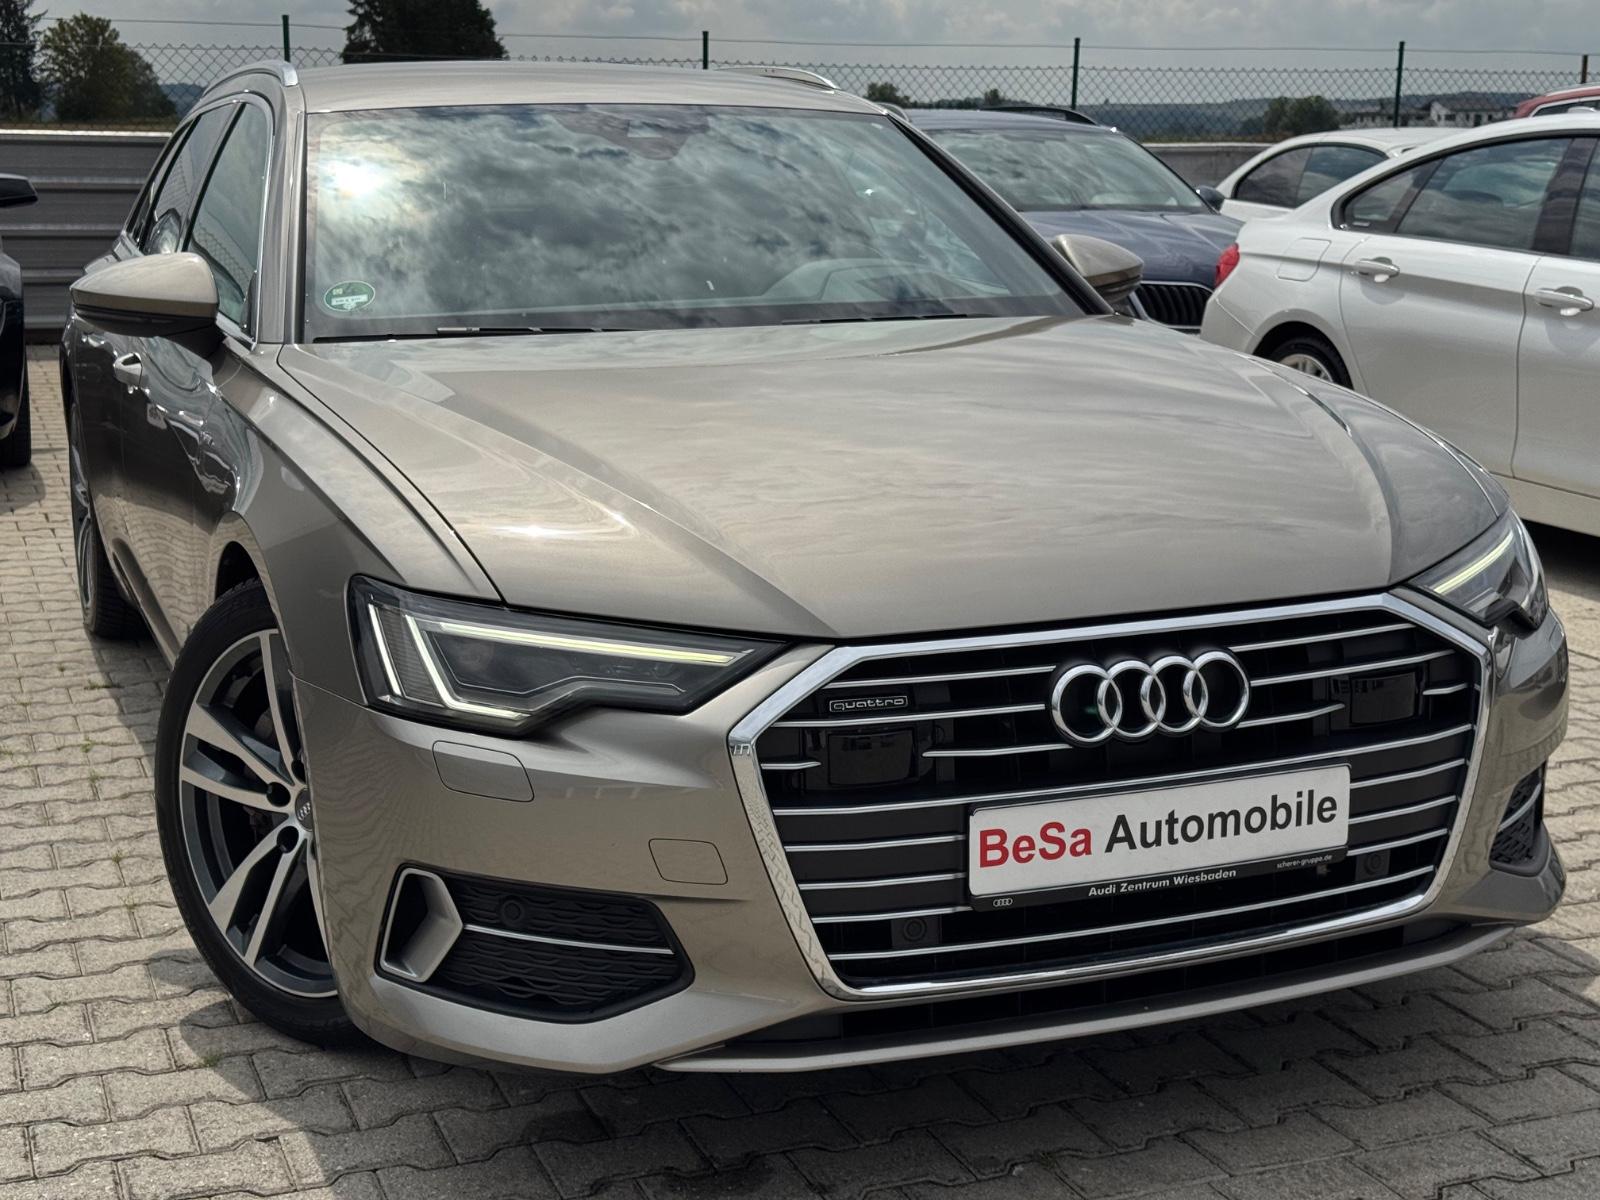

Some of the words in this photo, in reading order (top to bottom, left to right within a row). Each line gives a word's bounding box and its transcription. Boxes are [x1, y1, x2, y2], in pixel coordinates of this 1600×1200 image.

[833, 698, 904, 711] quattro
[979, 821, 1092, 868] BeSa
[1104, 789, 1337, 853] Automobile
[1088, 884, 1116, 897] Audi
[1120, 878, 1170, 893] Zentrum
[1173, 869, 1237, 885] Wiesbaden
